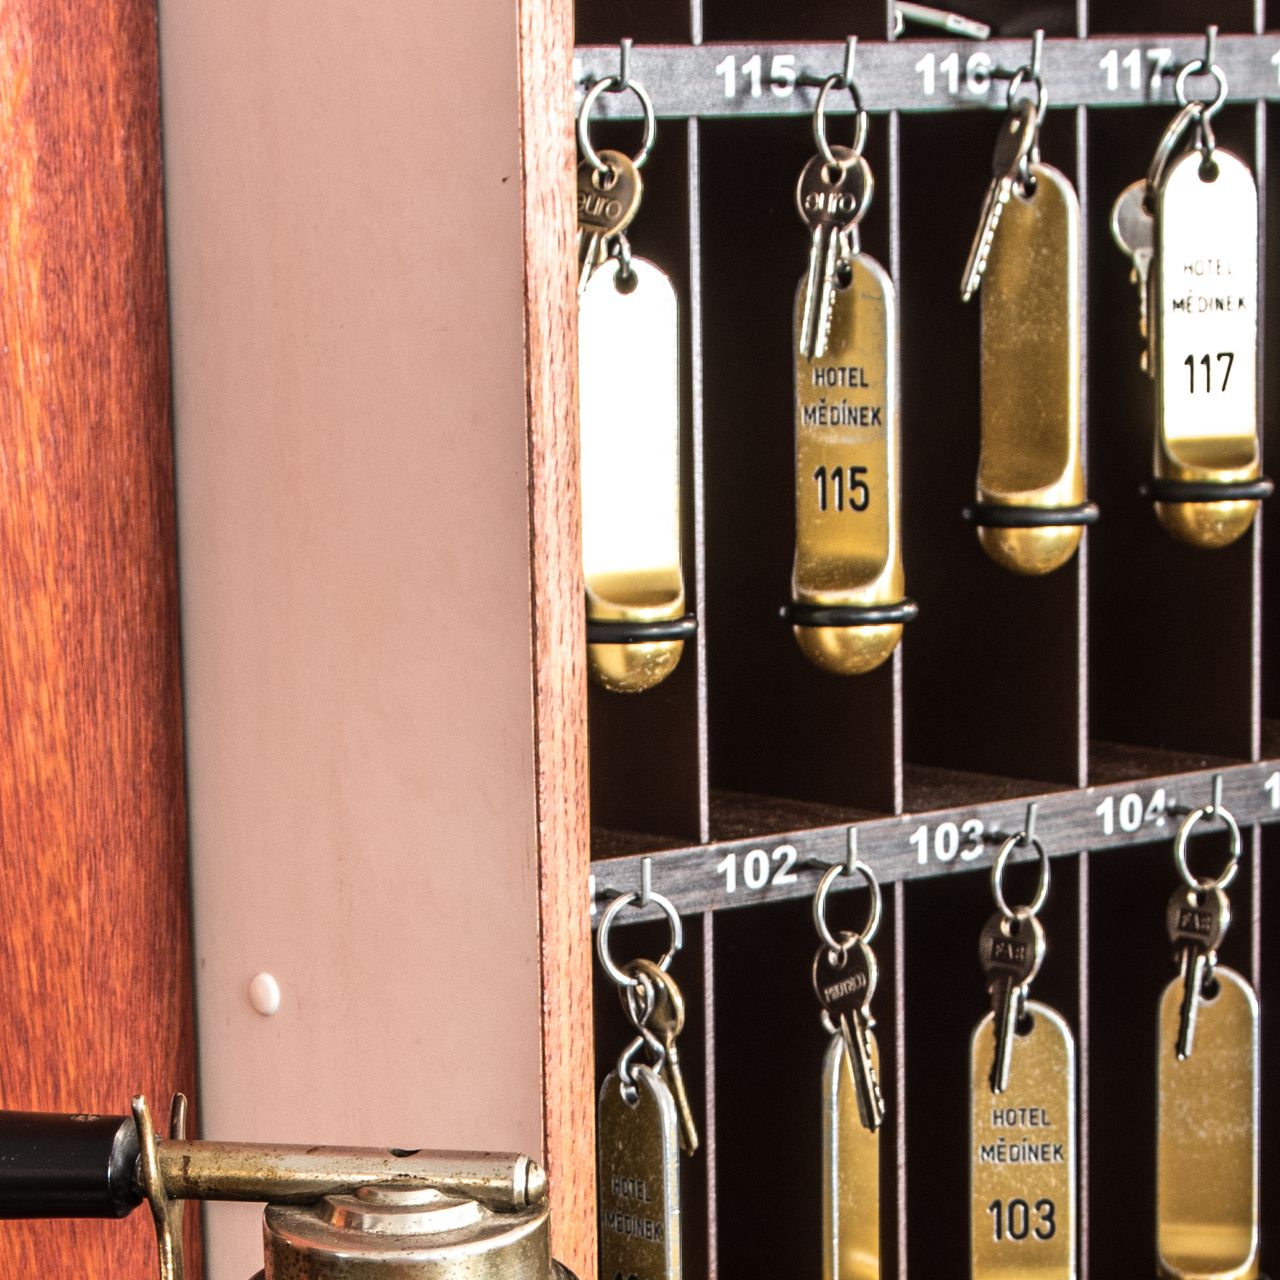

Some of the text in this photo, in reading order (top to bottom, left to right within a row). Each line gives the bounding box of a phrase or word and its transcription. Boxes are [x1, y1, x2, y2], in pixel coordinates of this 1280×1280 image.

[715, 54, 796, 98] 115
[915, 52, 991, 95] 116
[1100, 49, 1171, 91] 117
[812, 366, 869, 389] HOTEL
[1184, 352, 1235, 395] 117
[802, 399, 883, 428] MĚDÍNEK
[813, 466, 870, 513] 115
[1096, 786, 1167, 836] 104
[909, 819, 984, 865] 103
[717, 844, 798, 893] 102
[992, 1106, 1051, 1128] HOTEL
[979, 1136, 1065, 1163] MĚDÍNEK
[610, 1175, 652, 1203] HOTEL
[987, 1198, 1057, 1242] 103
